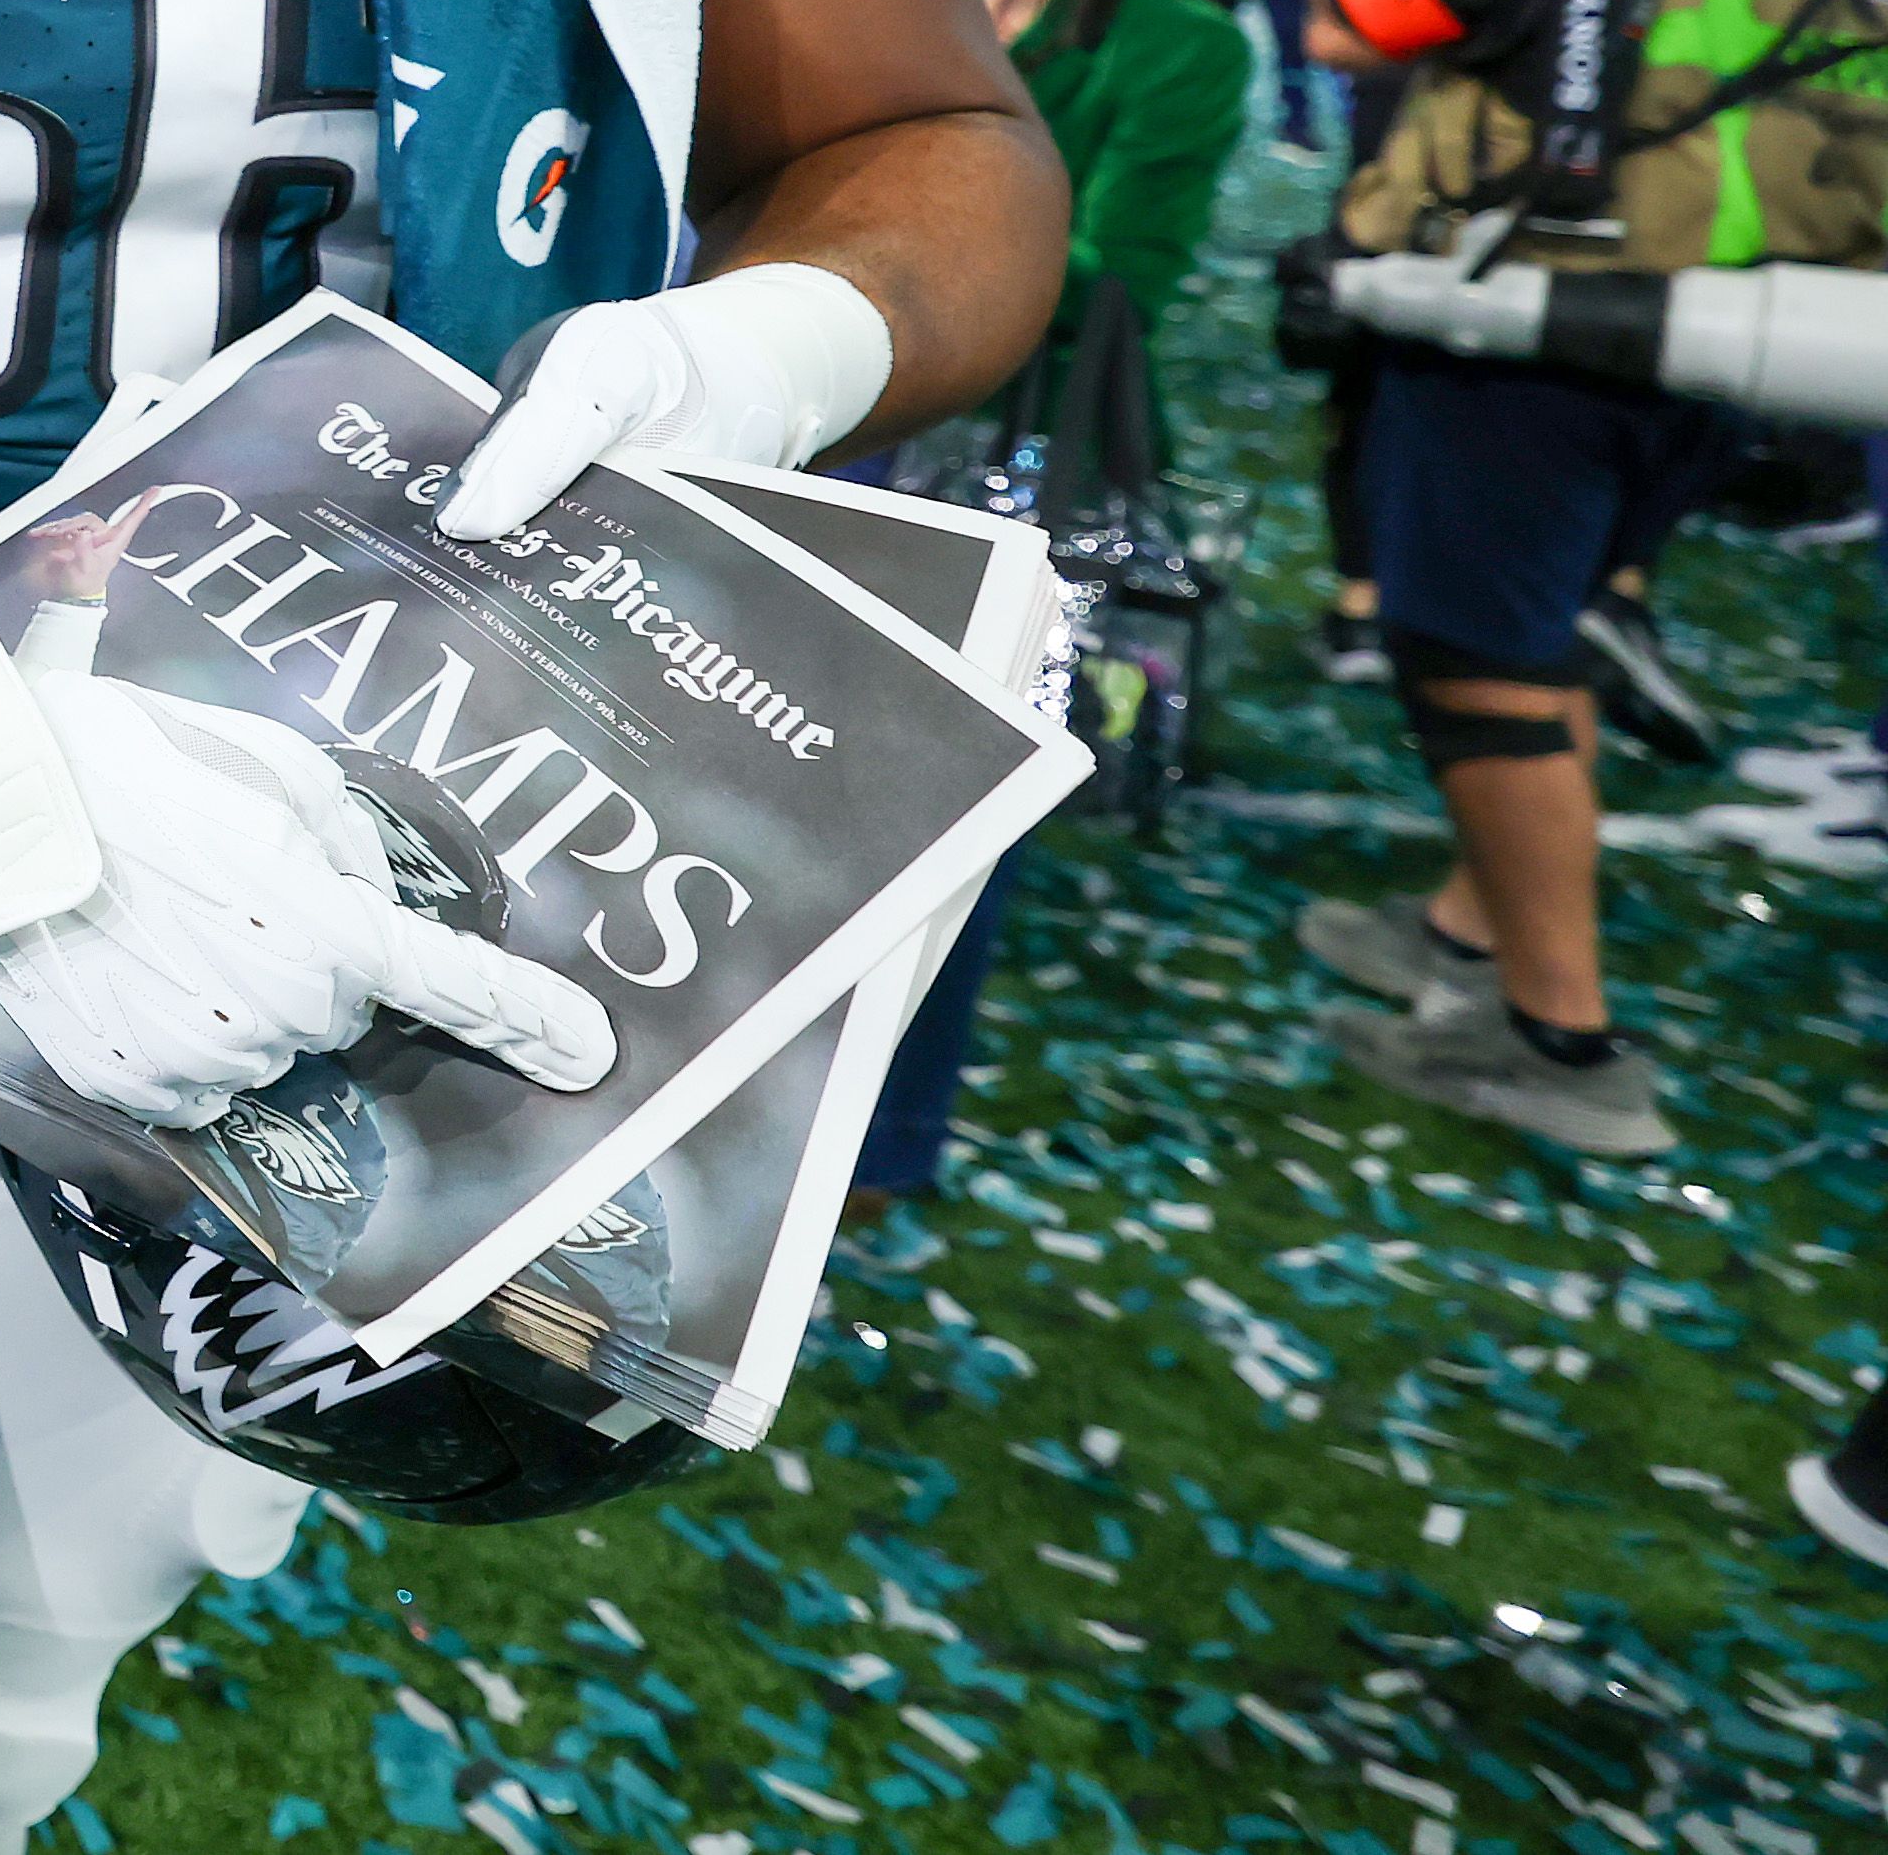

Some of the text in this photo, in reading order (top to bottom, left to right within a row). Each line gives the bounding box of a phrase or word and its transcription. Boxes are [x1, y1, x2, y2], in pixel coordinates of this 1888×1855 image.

[318, 401, 411, 480] The
[557, 497, 636, 539] NCE 1837
[479, 609, 530, 656] SUNDAY,
[529, 649, 599, 705] FEBRUARY
[594, 700, 618, 726] 9th,
[617, 719, 651, 747] 2025
[105, 482, 754, 988] CHAMPS
